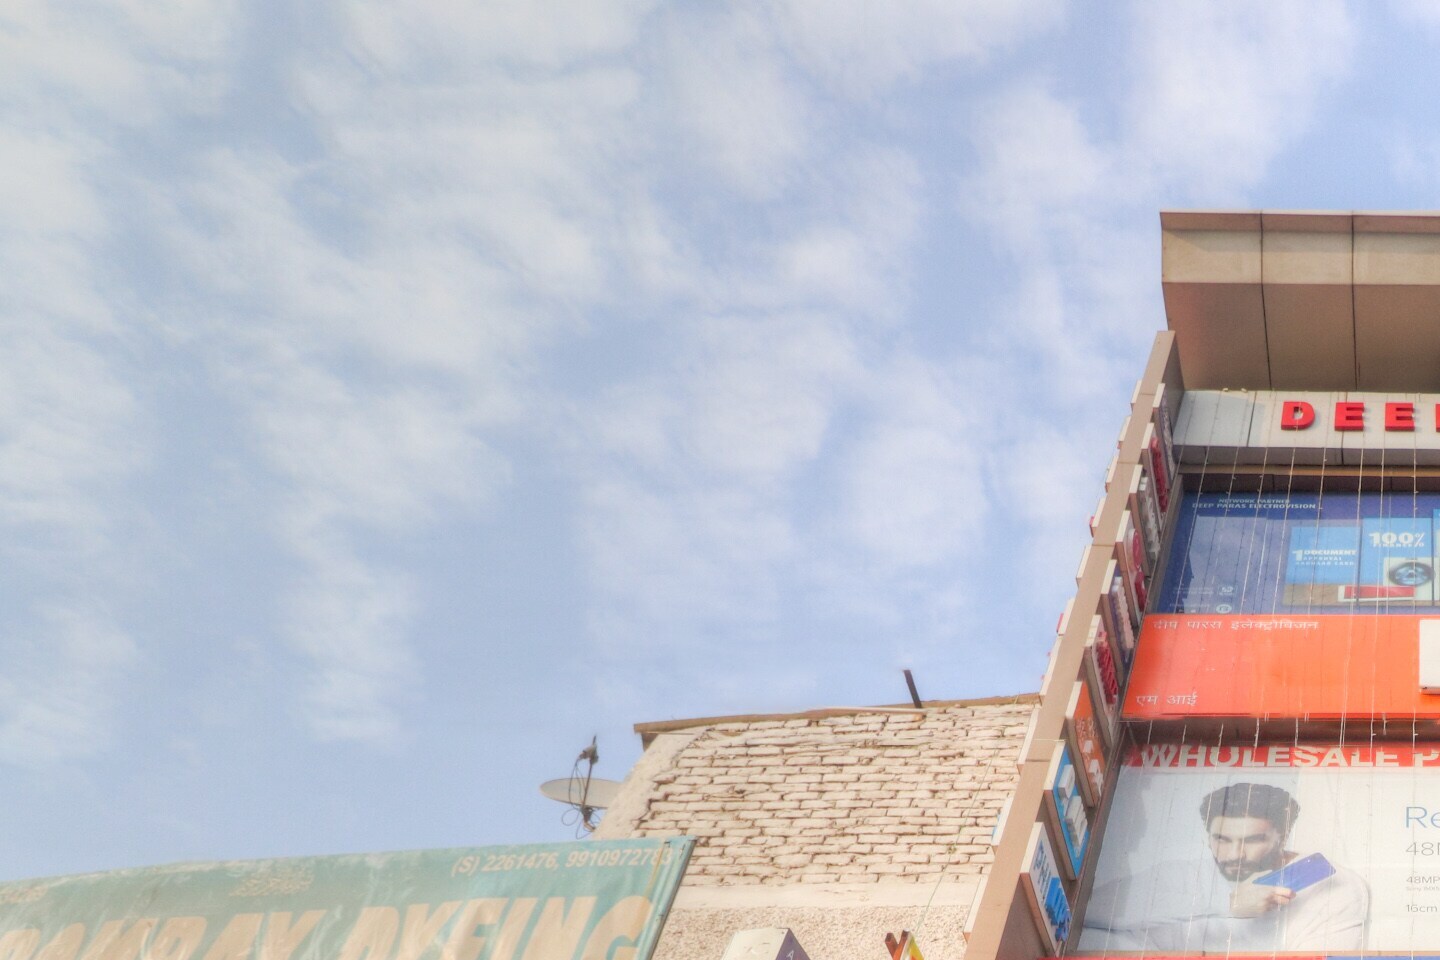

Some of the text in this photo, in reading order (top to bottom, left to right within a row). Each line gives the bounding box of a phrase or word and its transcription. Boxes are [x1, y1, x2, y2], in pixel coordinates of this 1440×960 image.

[1368, 532, 1425, 547] 100%
[1141, 745, 1400, 767] WHOLESALE
[1405, 876, 1440, 884] 48MP
[1406, 904, 1438, 913] 16cm
